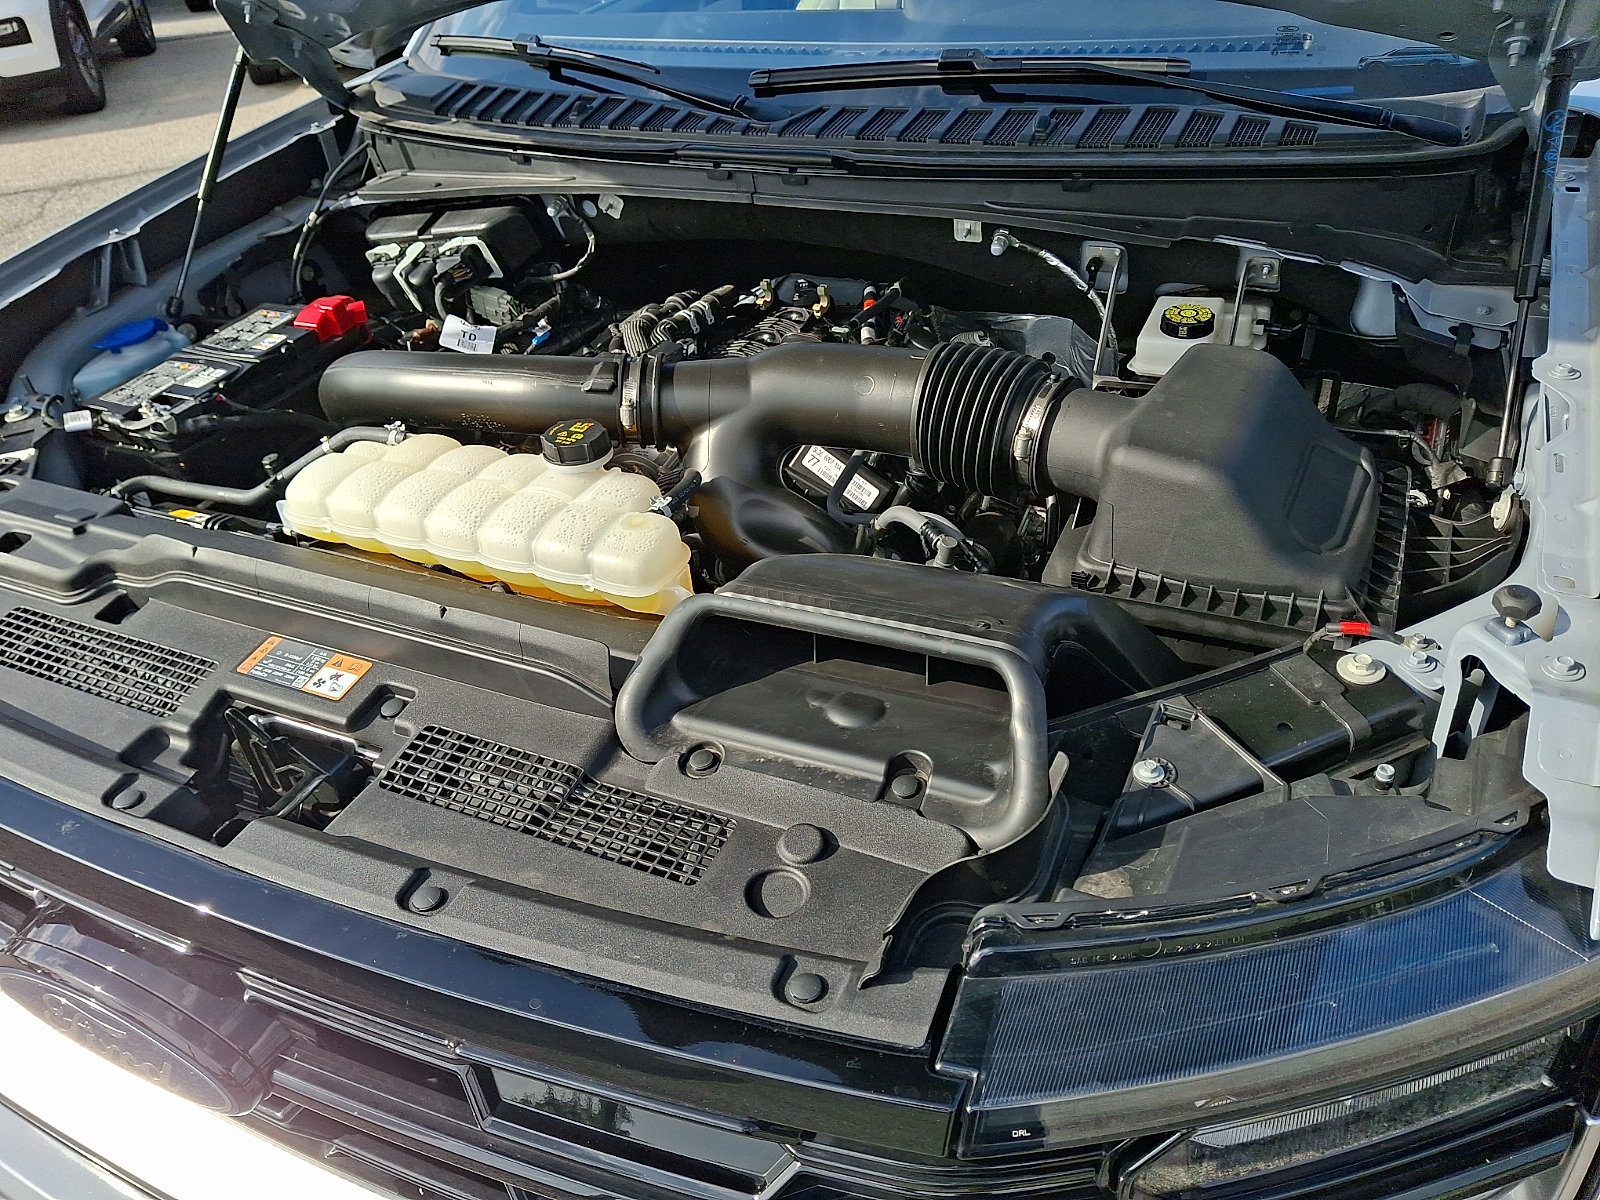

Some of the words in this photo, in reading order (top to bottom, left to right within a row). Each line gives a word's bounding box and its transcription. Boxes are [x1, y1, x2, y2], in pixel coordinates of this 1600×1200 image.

[461, 329, 477, 342] TD
[807, 453, 821, 467] 77
[1012, 1129, 1031, 1138] DRL
